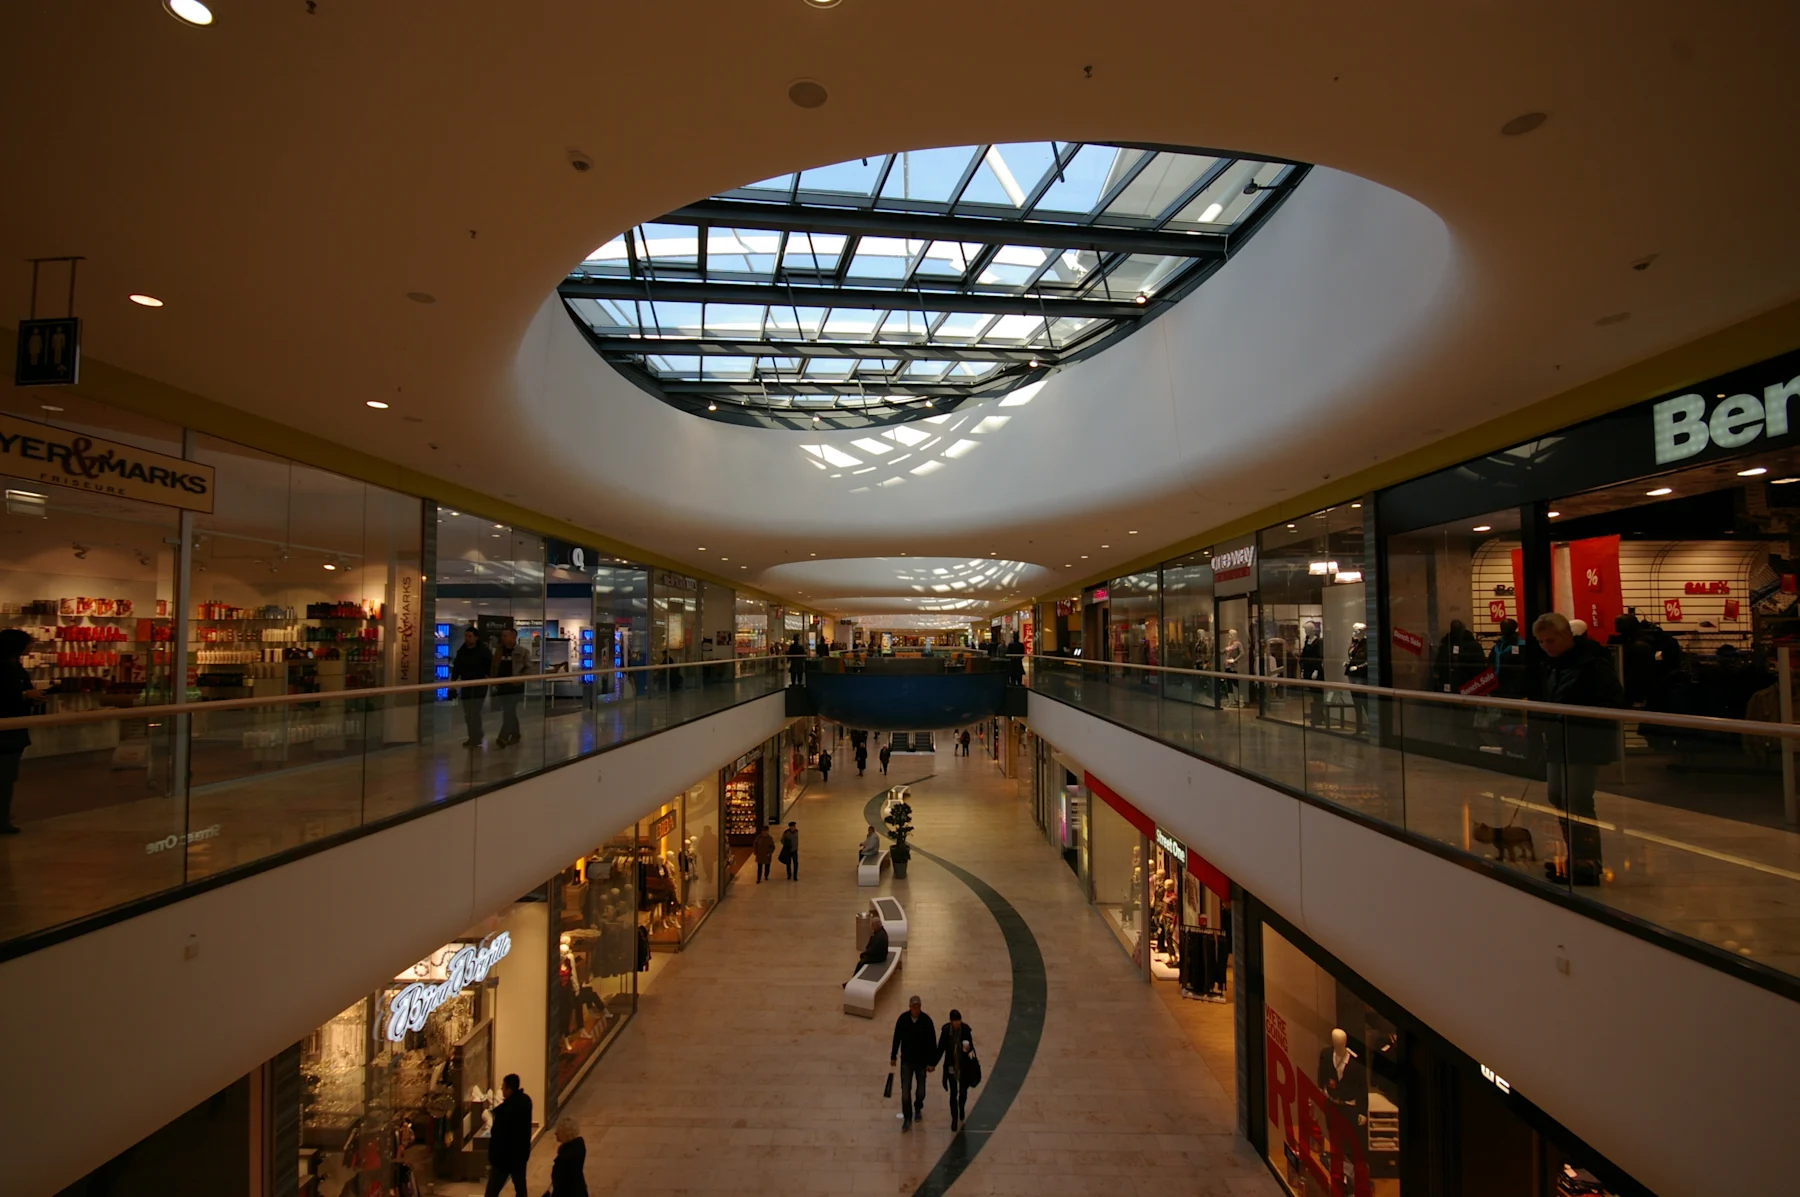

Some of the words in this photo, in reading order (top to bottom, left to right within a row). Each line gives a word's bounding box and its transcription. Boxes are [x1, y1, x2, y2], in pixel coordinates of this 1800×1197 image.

[40, 472, 125, 496] FRISEURE
[1156, 829, 1173, 854] Street
[1173, 841, 1186, 864] One
[1266, 1018, 1289, 1056] GOING
